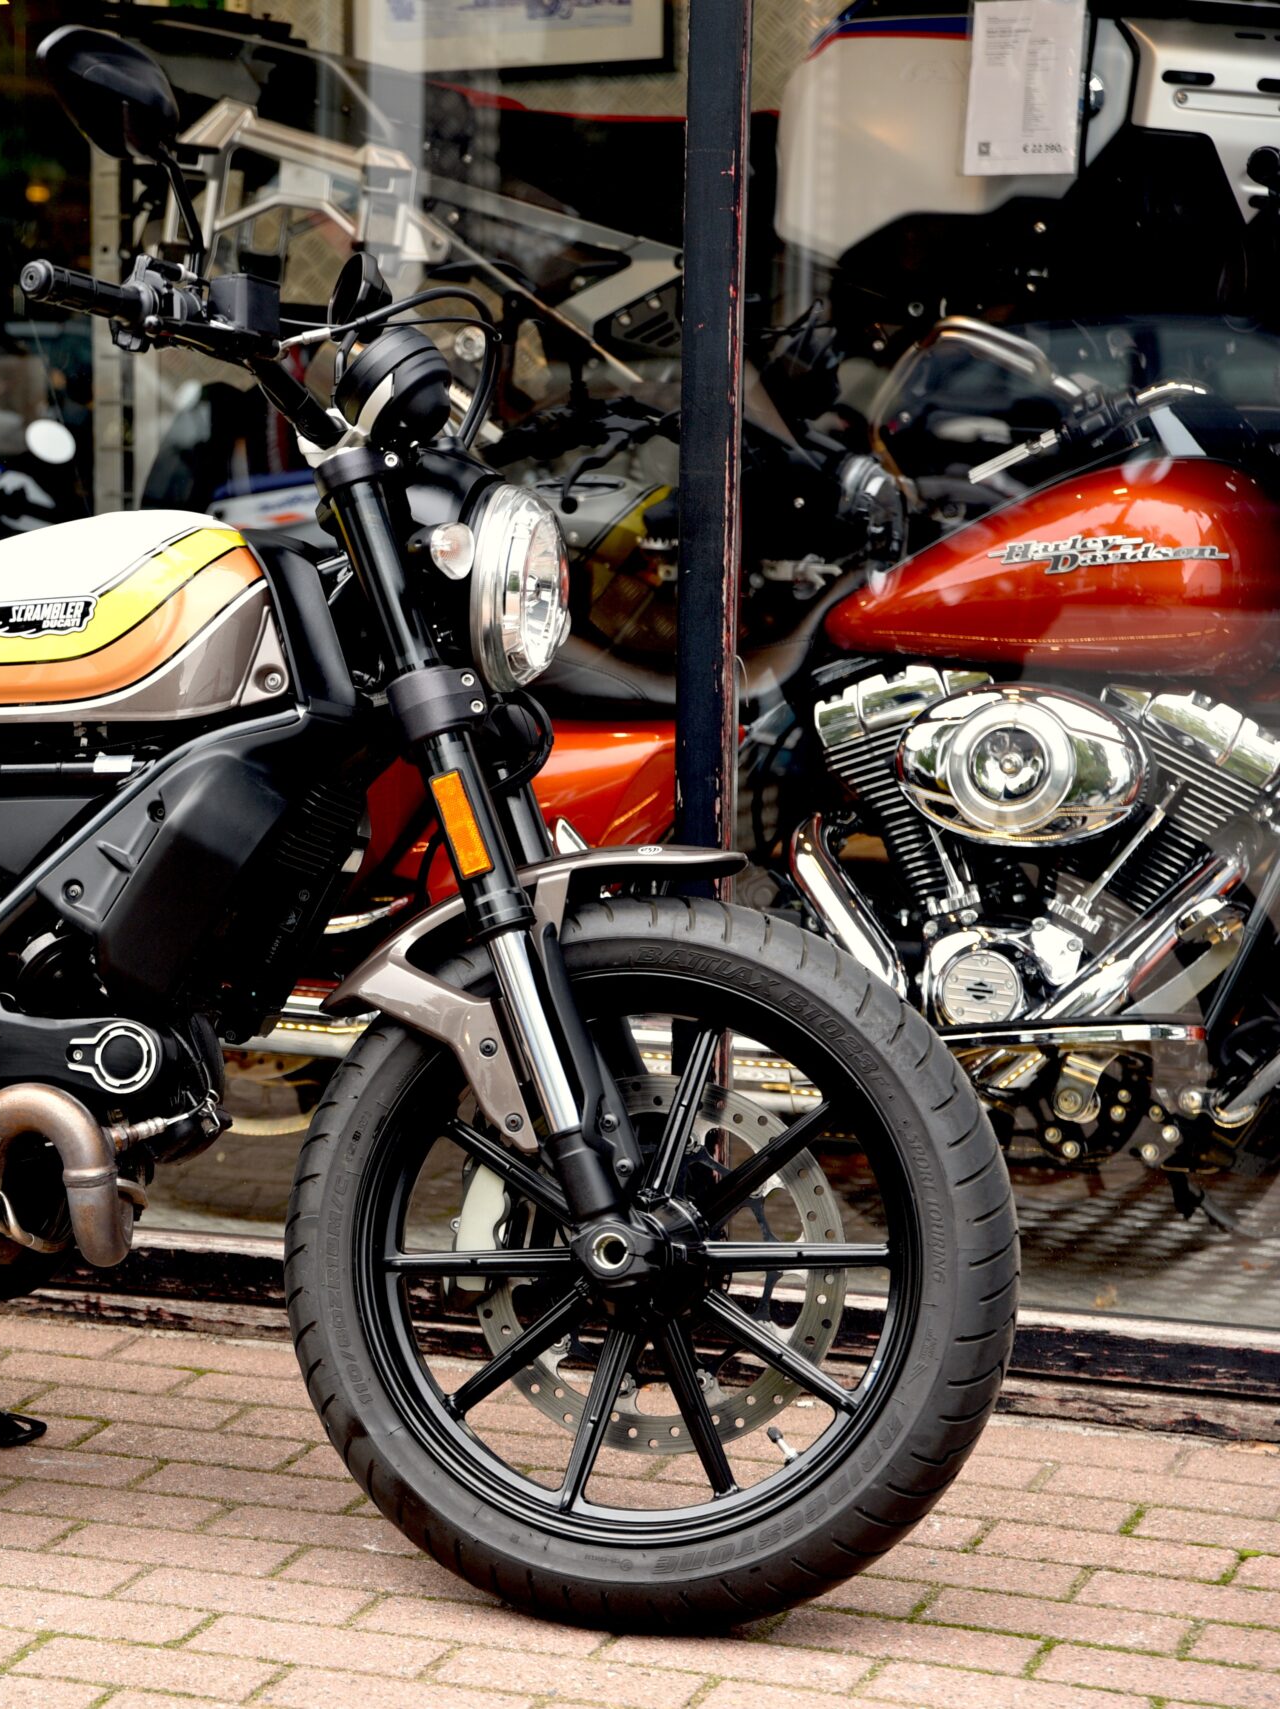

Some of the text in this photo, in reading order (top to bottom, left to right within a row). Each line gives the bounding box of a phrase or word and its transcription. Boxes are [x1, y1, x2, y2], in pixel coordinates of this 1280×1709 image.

[1044, 543, 1226, 576] Davidson
[8, 601, 85, 623] SCRAMBLER
[41, 617, 81, 629] DUCATI
[634, 945, 783, 997] BATTLAX
[925, 1198, 947, 1284] TOURING
[651, 1414, 904, 1575] BRIDGESTONE
